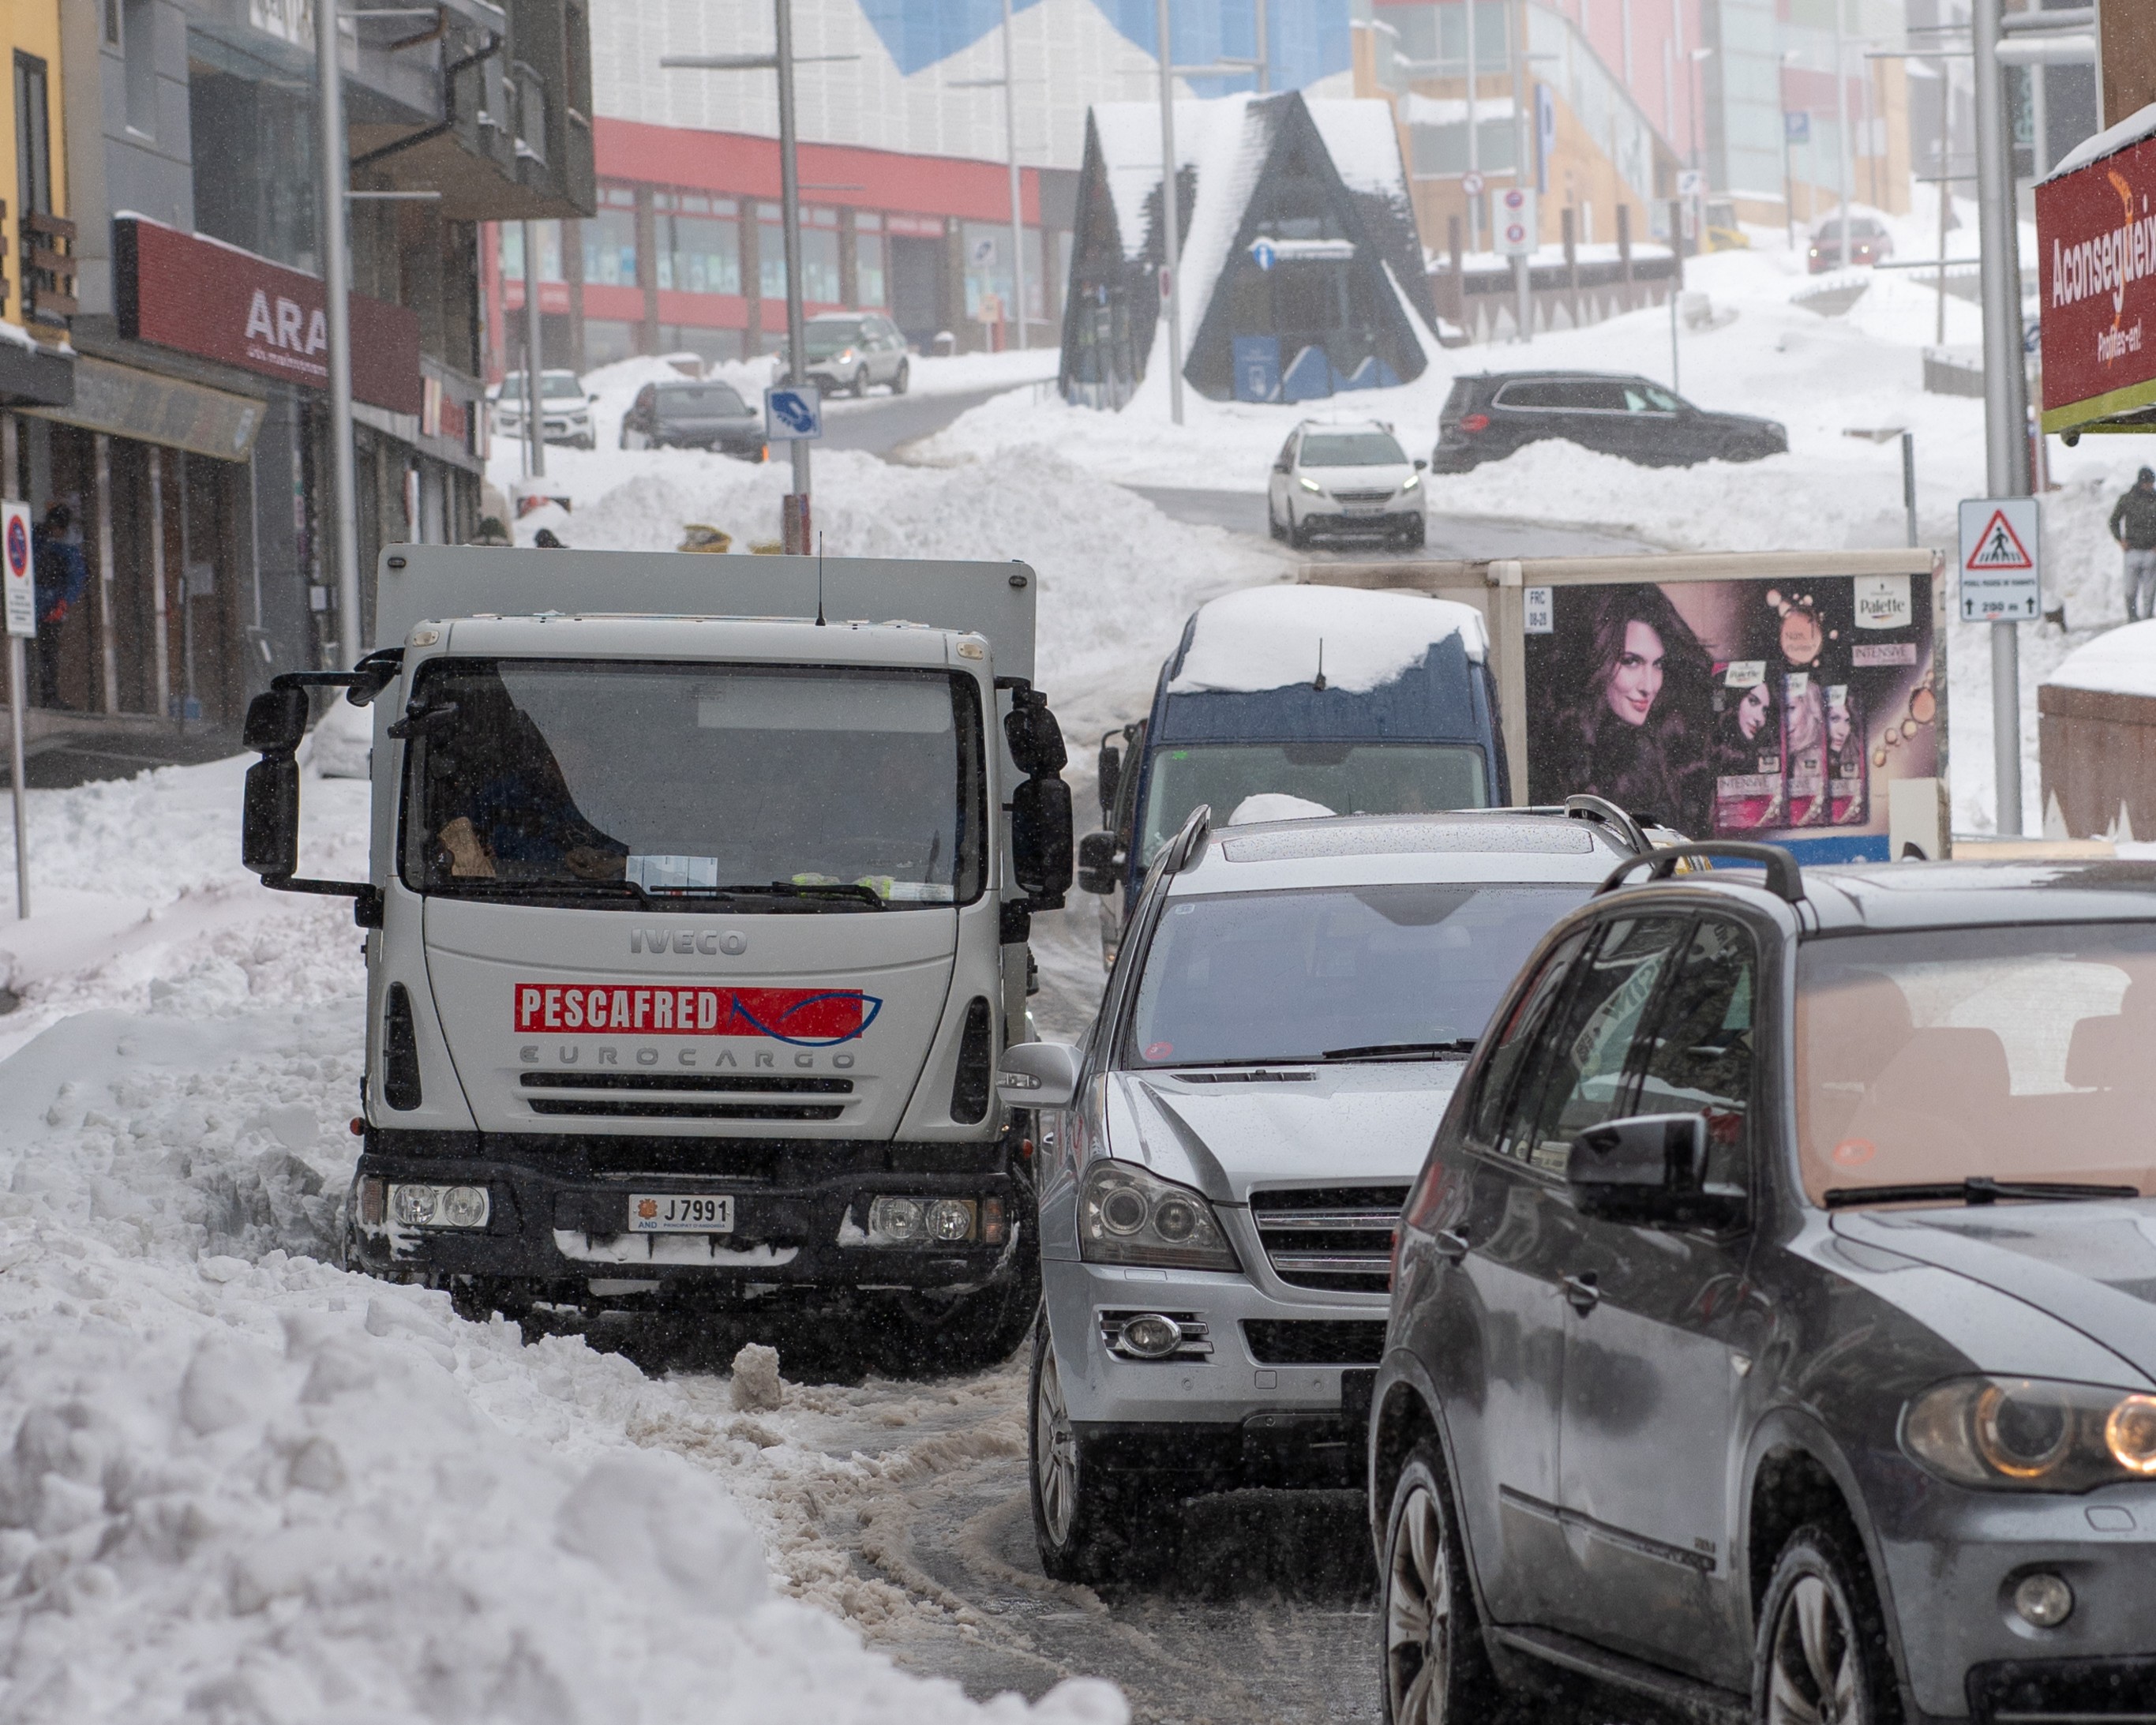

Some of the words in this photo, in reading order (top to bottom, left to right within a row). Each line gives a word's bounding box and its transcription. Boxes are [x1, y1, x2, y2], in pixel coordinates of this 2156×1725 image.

[1530, 591, 1545, 605] FRC
[1860, 598, 1906, 614] Palette
[1982, 601, 2004, 612] 200
[1856, 647, 1907, 658] INTENSIVE
[629, 927, 749, 957] IVECO
[521, 988, 718, 1029] PESCAFRED
[519, 1044, 856, 1070] EUROCARGO
